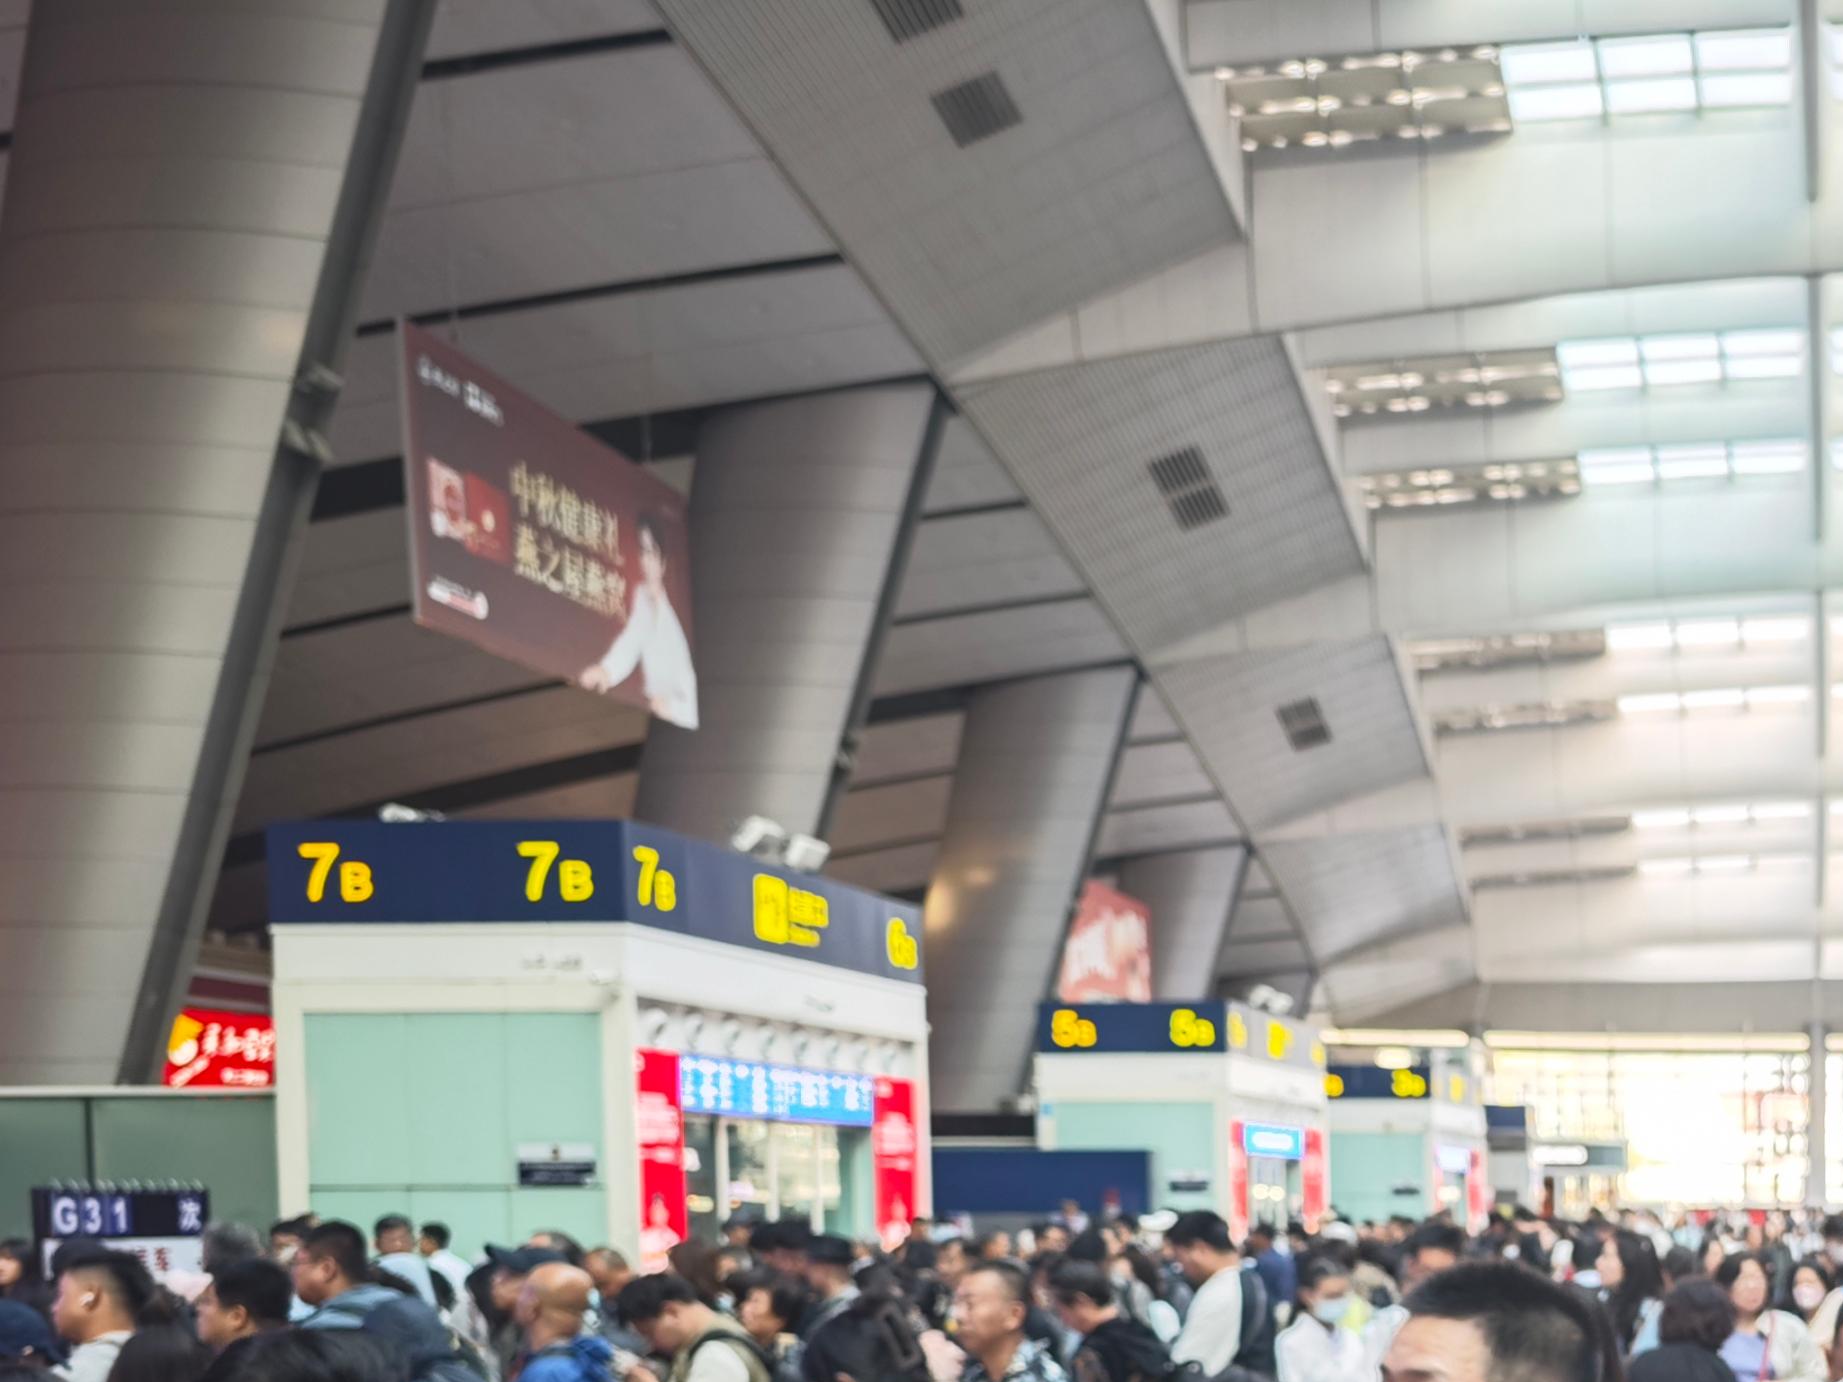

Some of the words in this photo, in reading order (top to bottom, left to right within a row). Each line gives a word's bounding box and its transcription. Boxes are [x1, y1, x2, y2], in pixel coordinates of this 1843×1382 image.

[298, 841, 374, 902] 7B
[517, 840, 594, 902] 7B
[632, 845, 677, 912] 7B
[53, 1197, 127, 1234] G31
